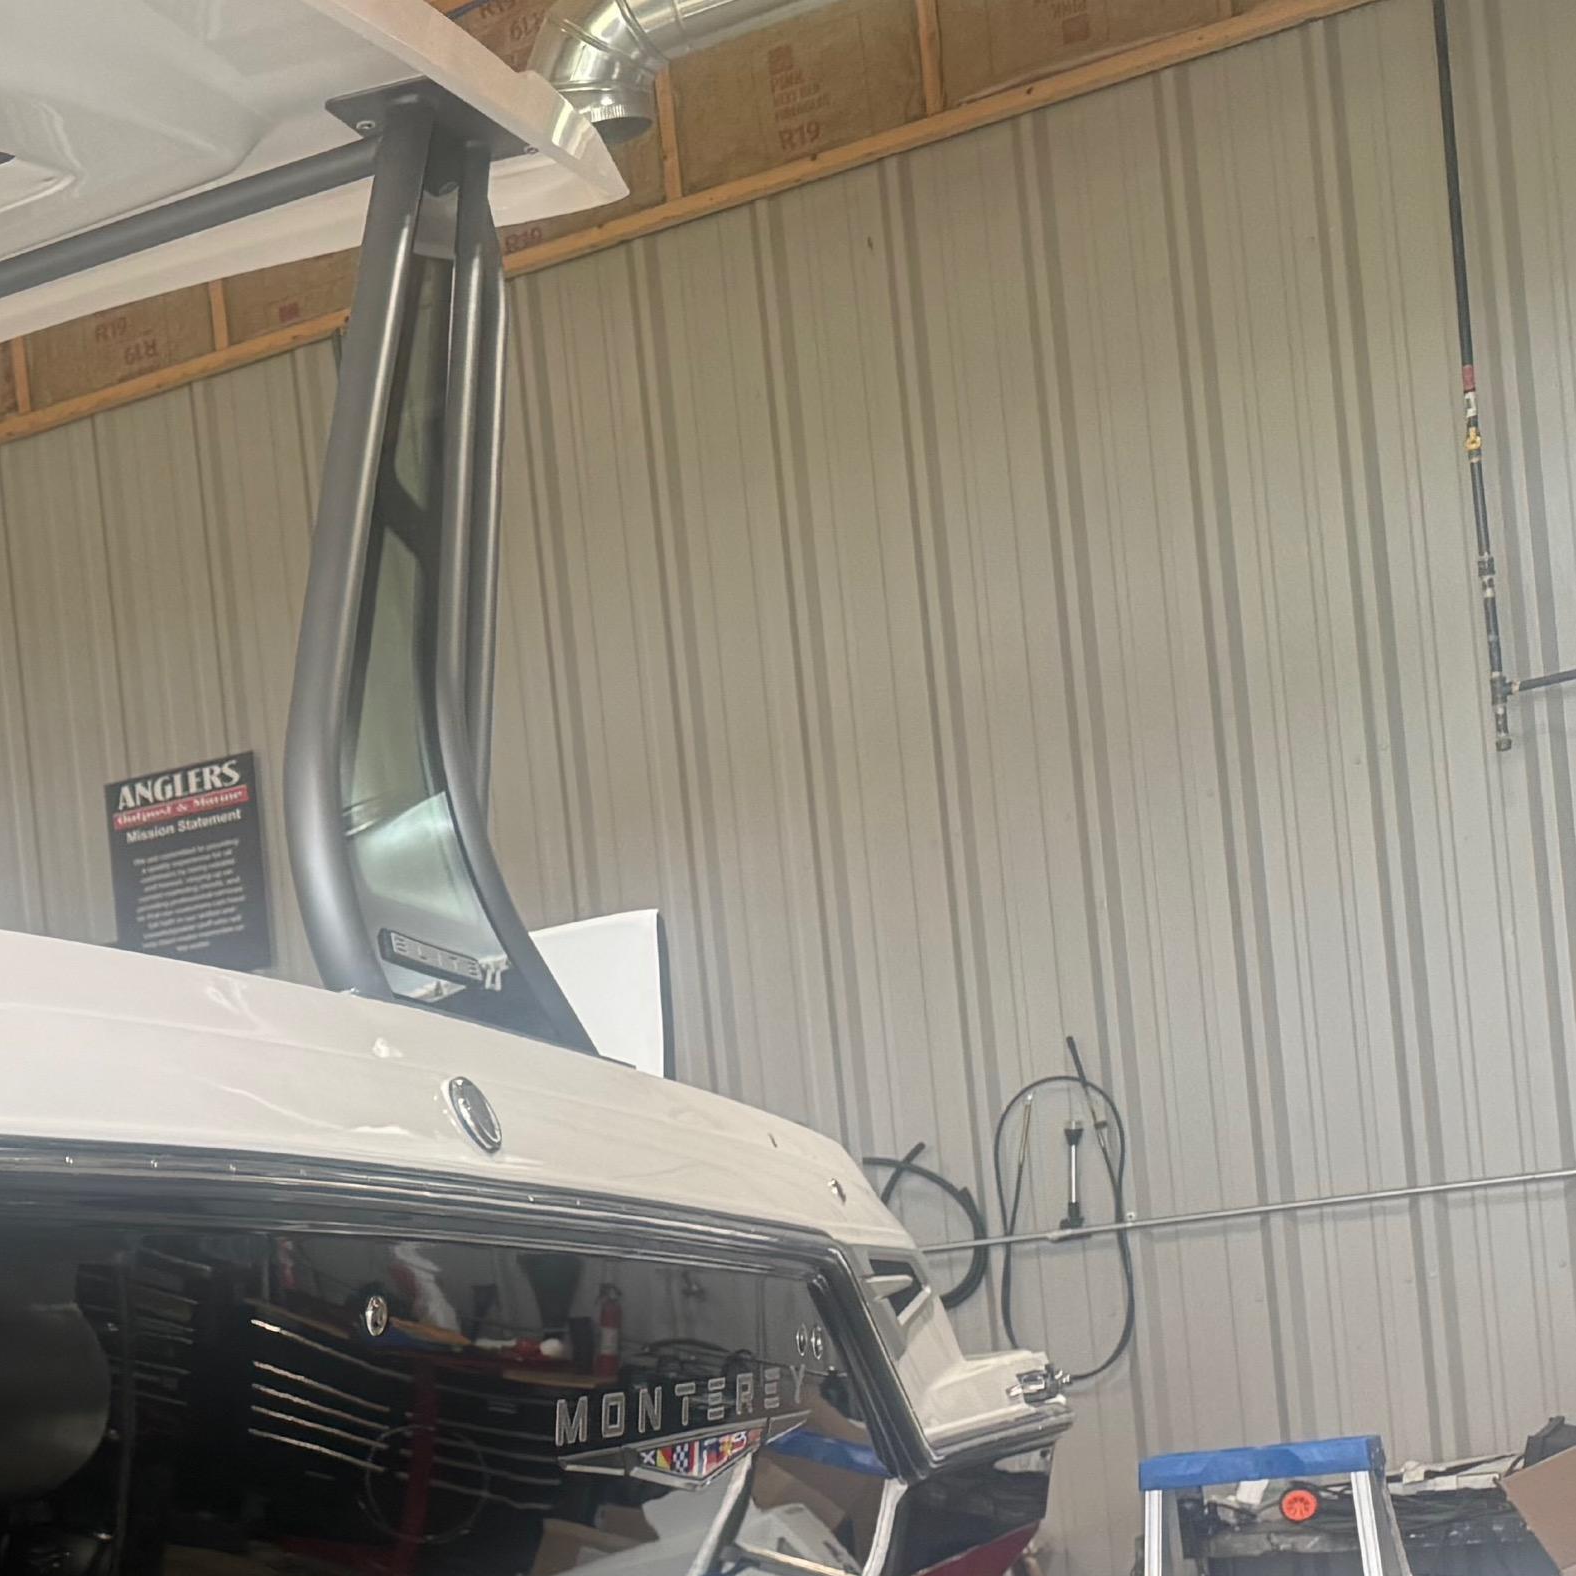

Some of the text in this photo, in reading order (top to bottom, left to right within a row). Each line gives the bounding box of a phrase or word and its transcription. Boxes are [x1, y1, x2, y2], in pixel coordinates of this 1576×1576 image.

[779, 121, 820, 151] R19
[95, 317, 128, 343] R19
[124, 339, 158, 365] R19
[118, 760, 240, 810] ANGLERS
[126, 808, 242, 843] Mission Statement
[394, 933, 481, 977] ELITE
[555, 1364, 806, 1447] MONTEREY
